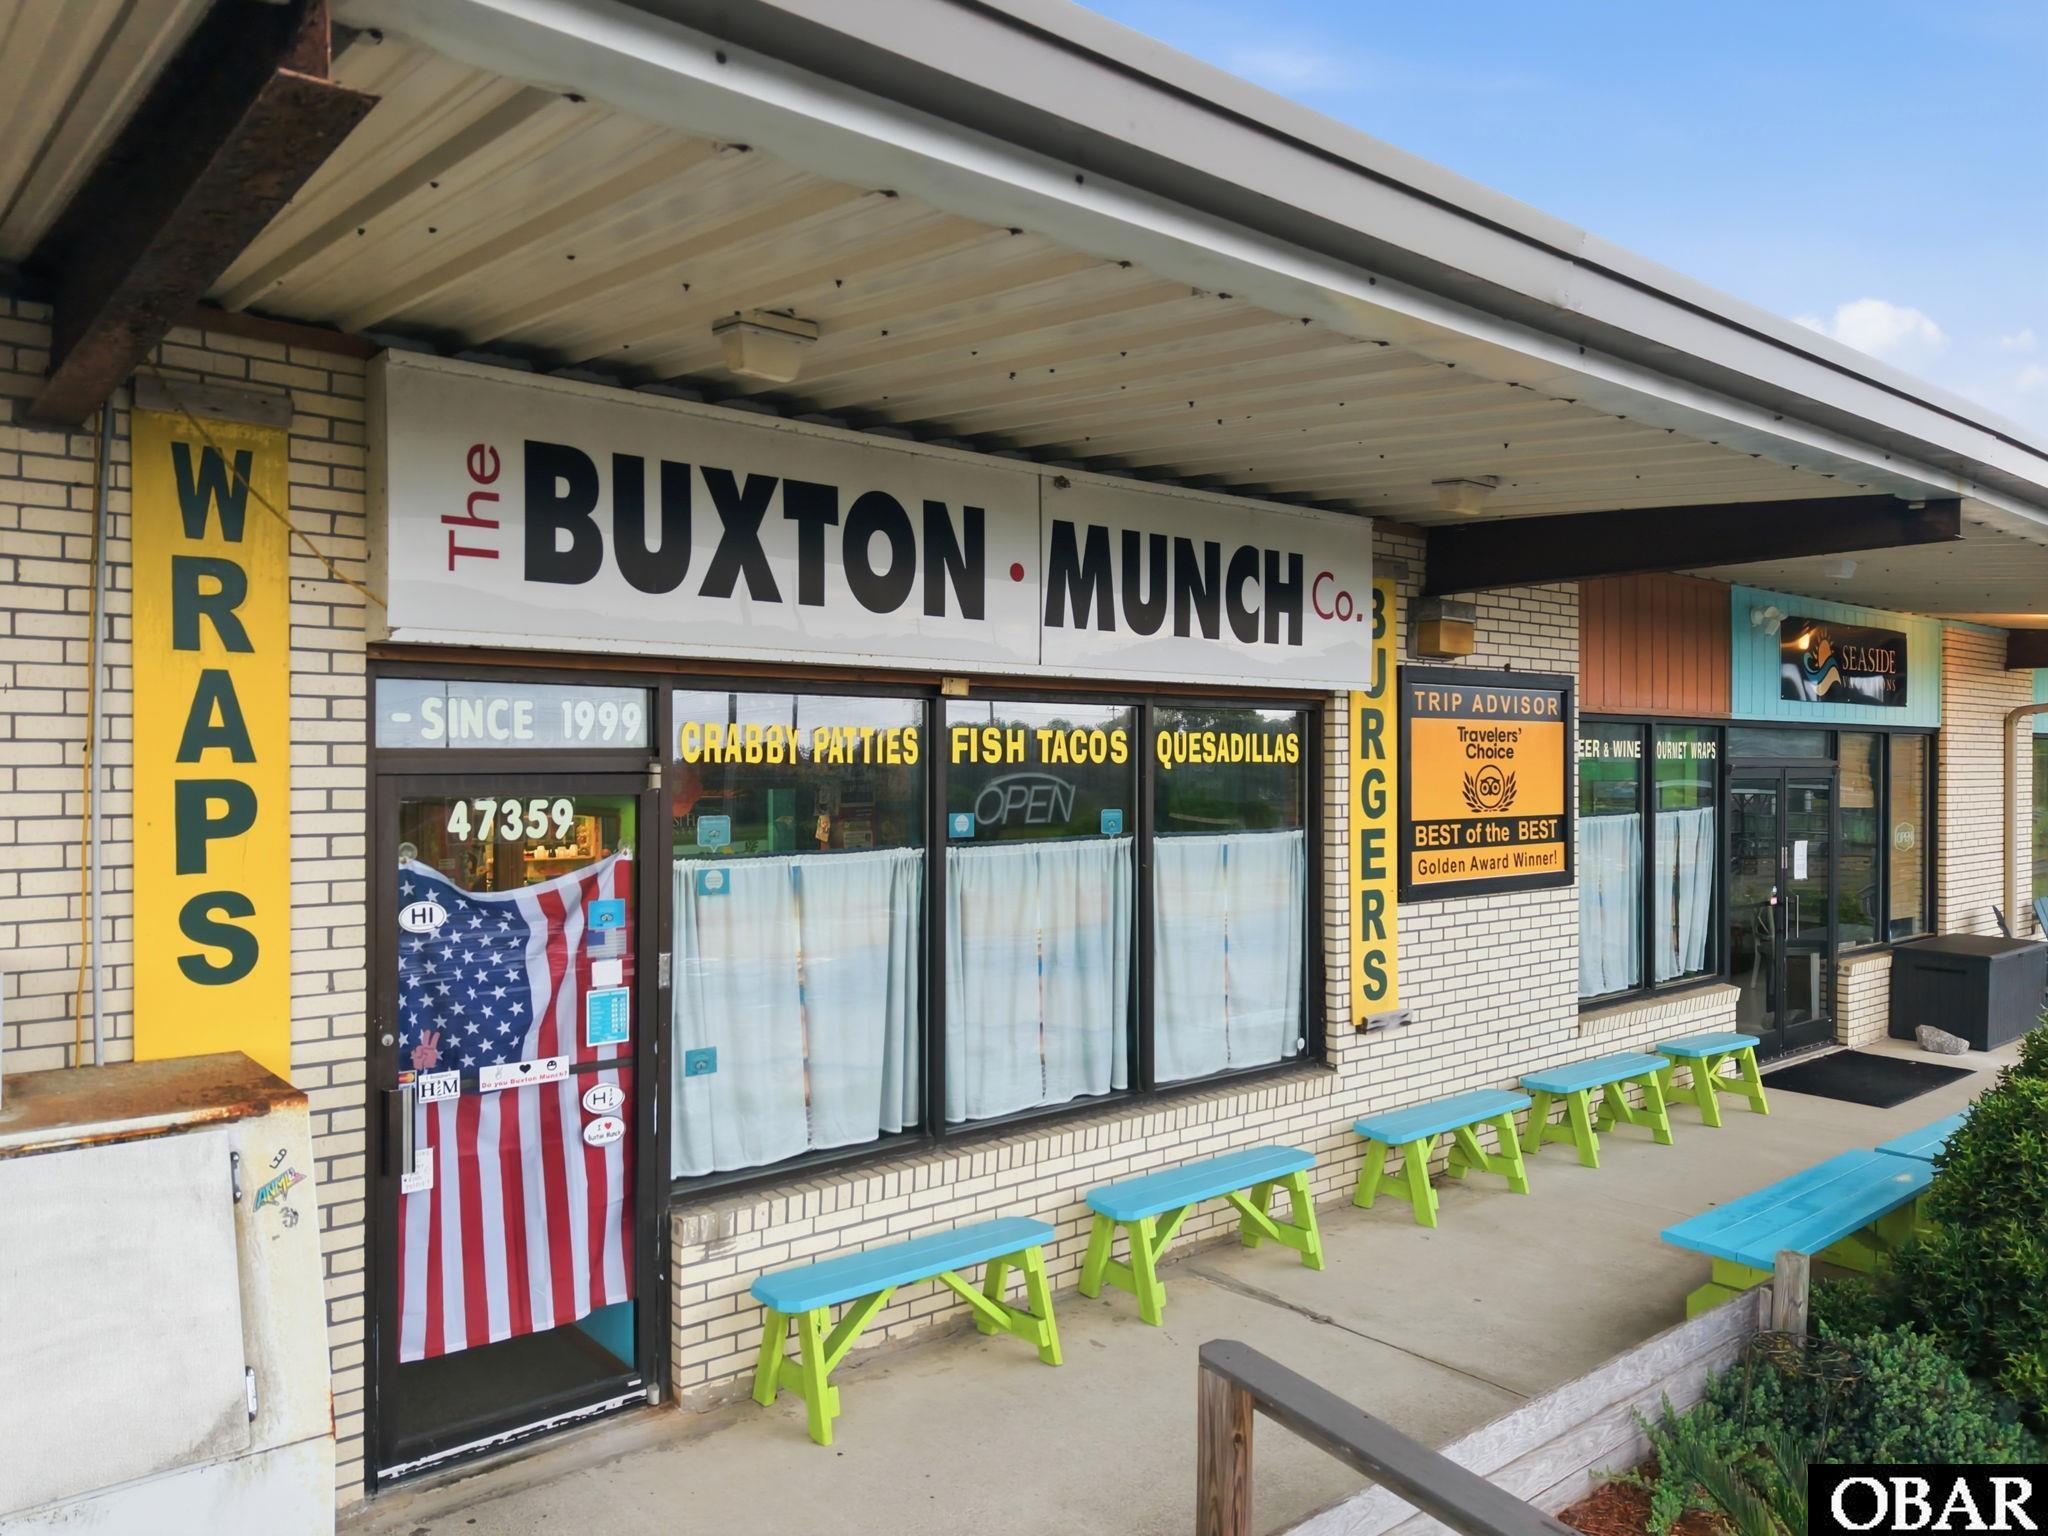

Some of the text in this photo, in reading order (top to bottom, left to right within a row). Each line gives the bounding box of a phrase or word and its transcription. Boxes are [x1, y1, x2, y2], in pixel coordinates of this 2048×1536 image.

[441, 443, 501, 572] The
[523, 438, 1363, 647] BUXTON MUNCH Co.
[1842, 644, 1896, 674] SEASIDE
[170, 441, 260, 987] WRAPS
[420, 696, 535, 741] SINCE
[560, 700, 643, 742] 1999
[1414, 690, 1559, 717] TRIP ADVISOR
[680, 720, 920, 766] CRABBY PATTIES
[951, 726, 1129, 765] FISH TACOS
[1156, 729, 1301, 770] QUESADILLAS
[1457, 726, 1523, 744] Travelers'
[1466, 743, 1515, 760] Choice
[1578, 739, 1601, 758] EER
[1612, 740, 1642, 759] WINE
[1656, 741, 1717, 760] OURMET WRAPS
[447, 798, 575, 842] 47359
[974, 785, 1077, 826] OPEN
[1415, 819, 1558, 847] BEST of the BEST
[1418, 850, 1558, 876] Golden Award Winner!
[410, 906, 434, 925] HI
